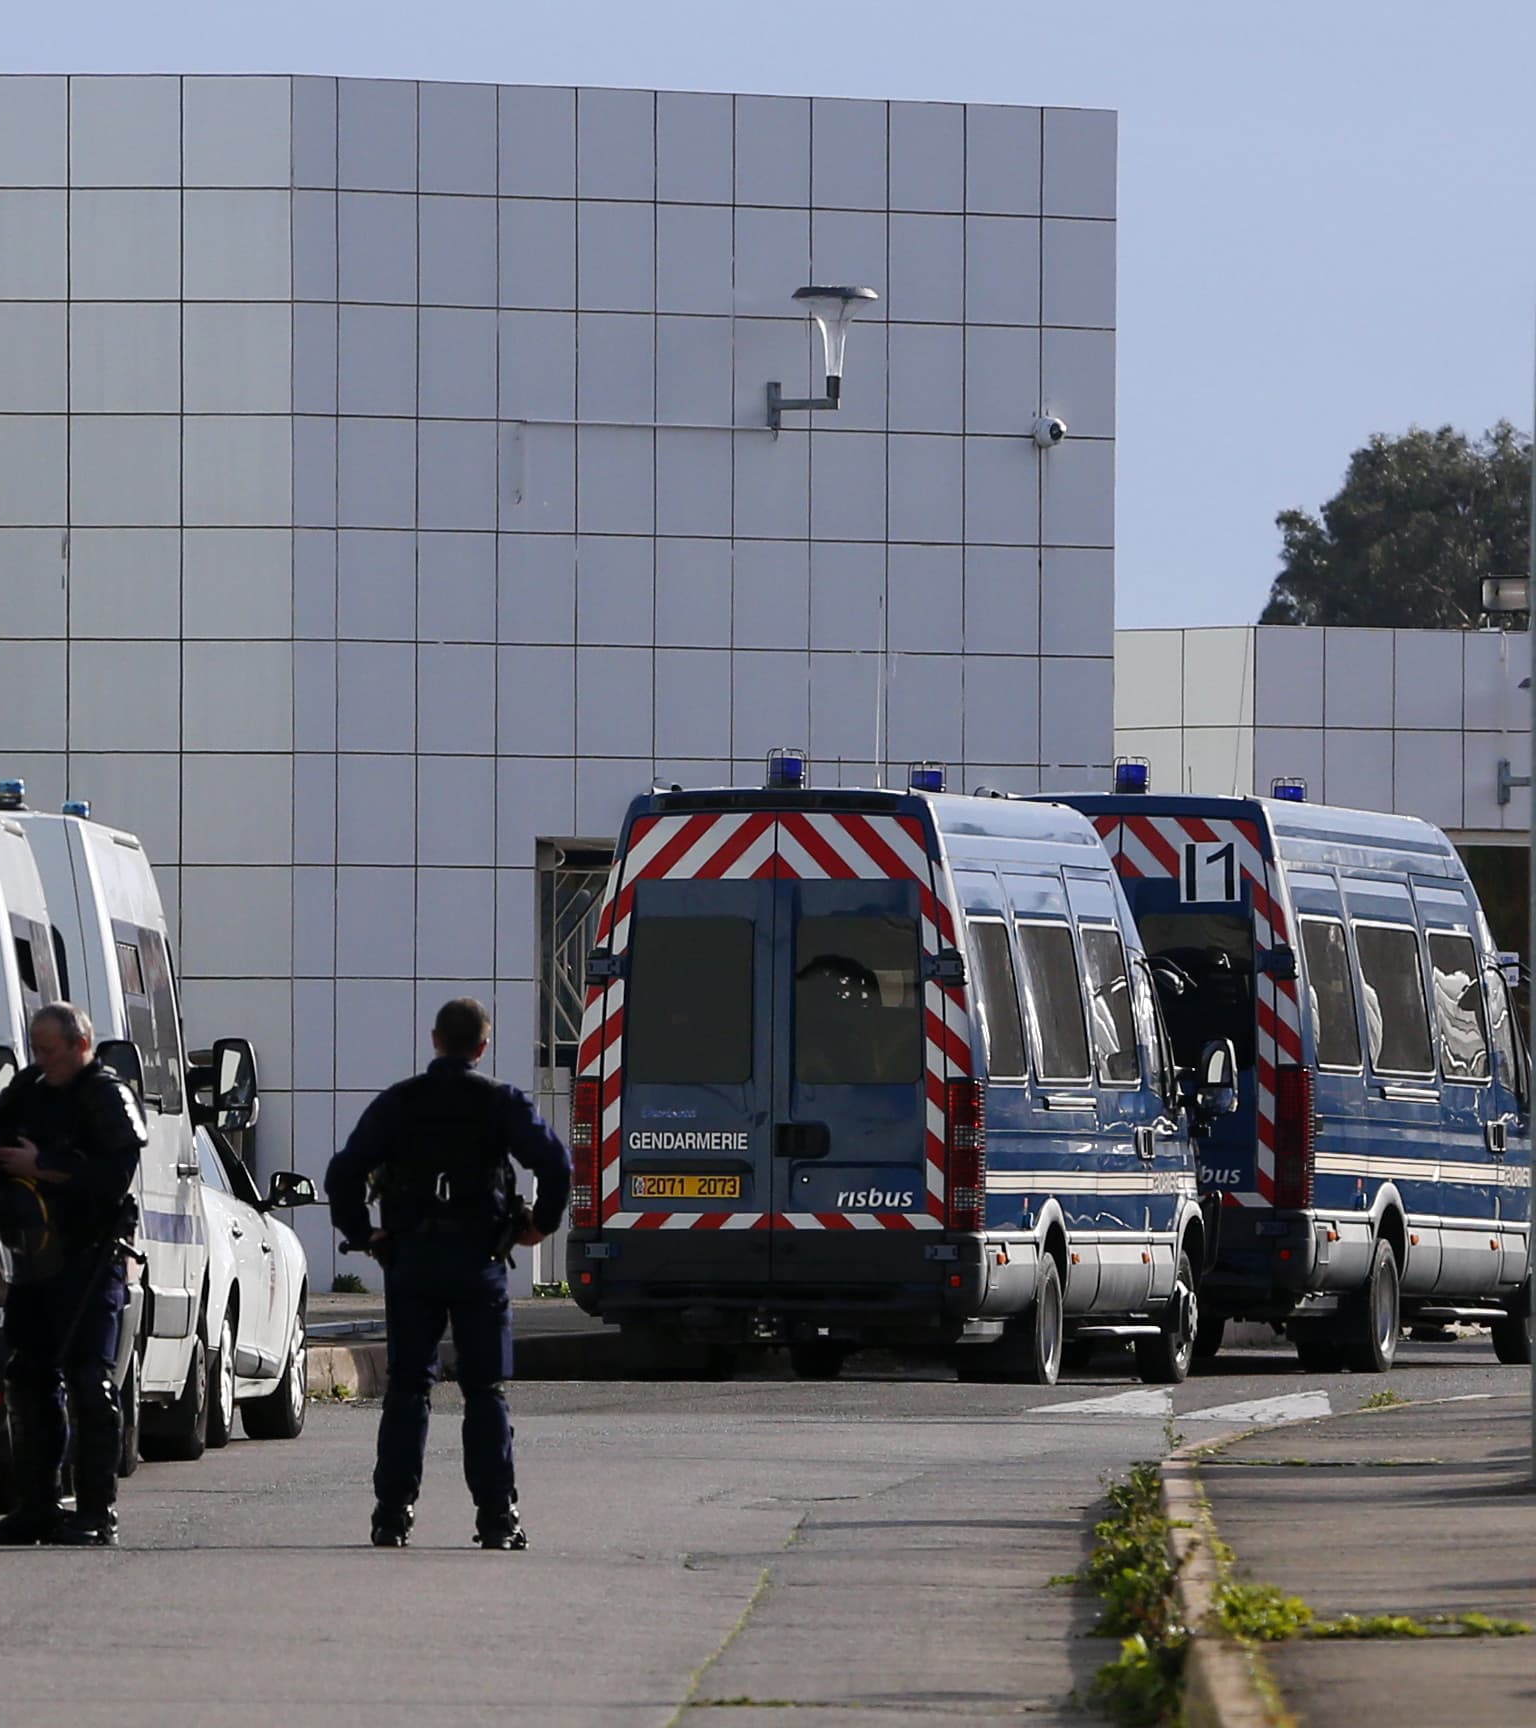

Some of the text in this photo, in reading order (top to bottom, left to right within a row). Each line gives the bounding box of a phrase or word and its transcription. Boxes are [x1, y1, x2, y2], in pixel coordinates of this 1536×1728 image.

[629, 1131, 749, 1150] GENDARMERIE
[647, 1178, 737, 1195] 2071 2073
